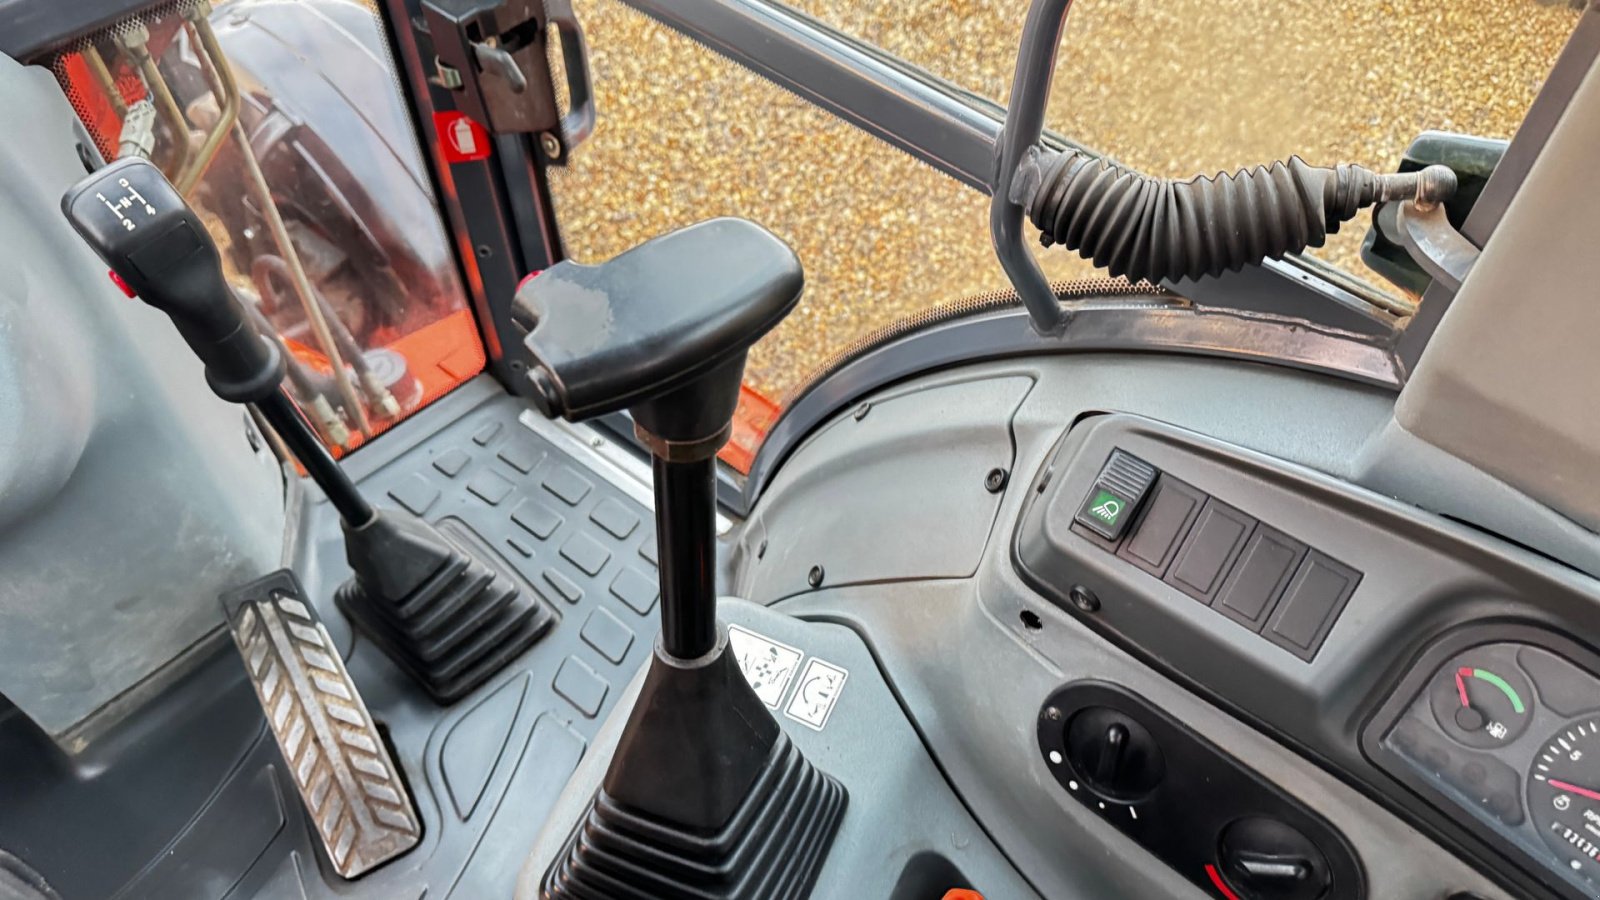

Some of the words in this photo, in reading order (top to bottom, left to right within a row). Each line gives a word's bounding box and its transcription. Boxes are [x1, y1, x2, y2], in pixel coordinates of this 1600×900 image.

[96, 192, 106, 202] 1
[145, 204, 156, 215] 4
[122, 218, 136, 231] 2
[1569, 750, 1582, 761] 5
